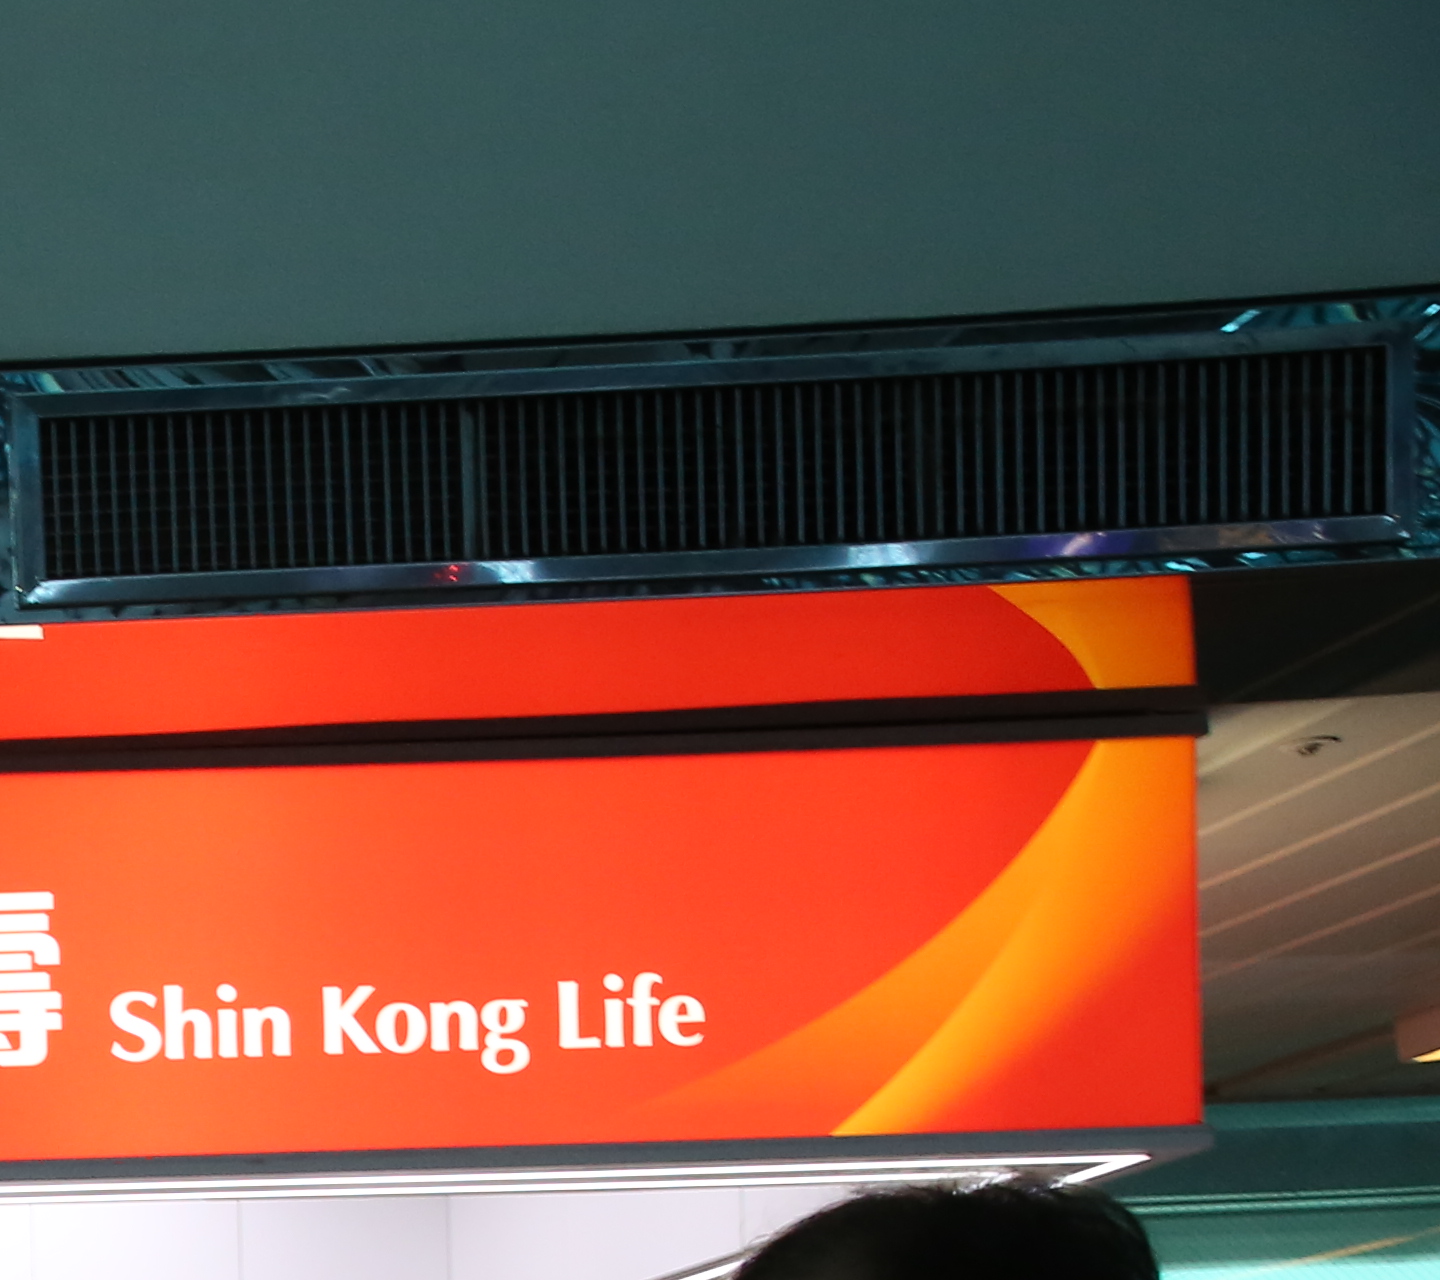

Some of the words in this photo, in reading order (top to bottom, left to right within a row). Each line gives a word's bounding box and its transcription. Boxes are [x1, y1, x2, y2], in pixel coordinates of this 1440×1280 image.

[109, 983, 292, 1063] Shin
[321, 983, 531, 1075] Kong
[557, 972, 706, 1051] Life
